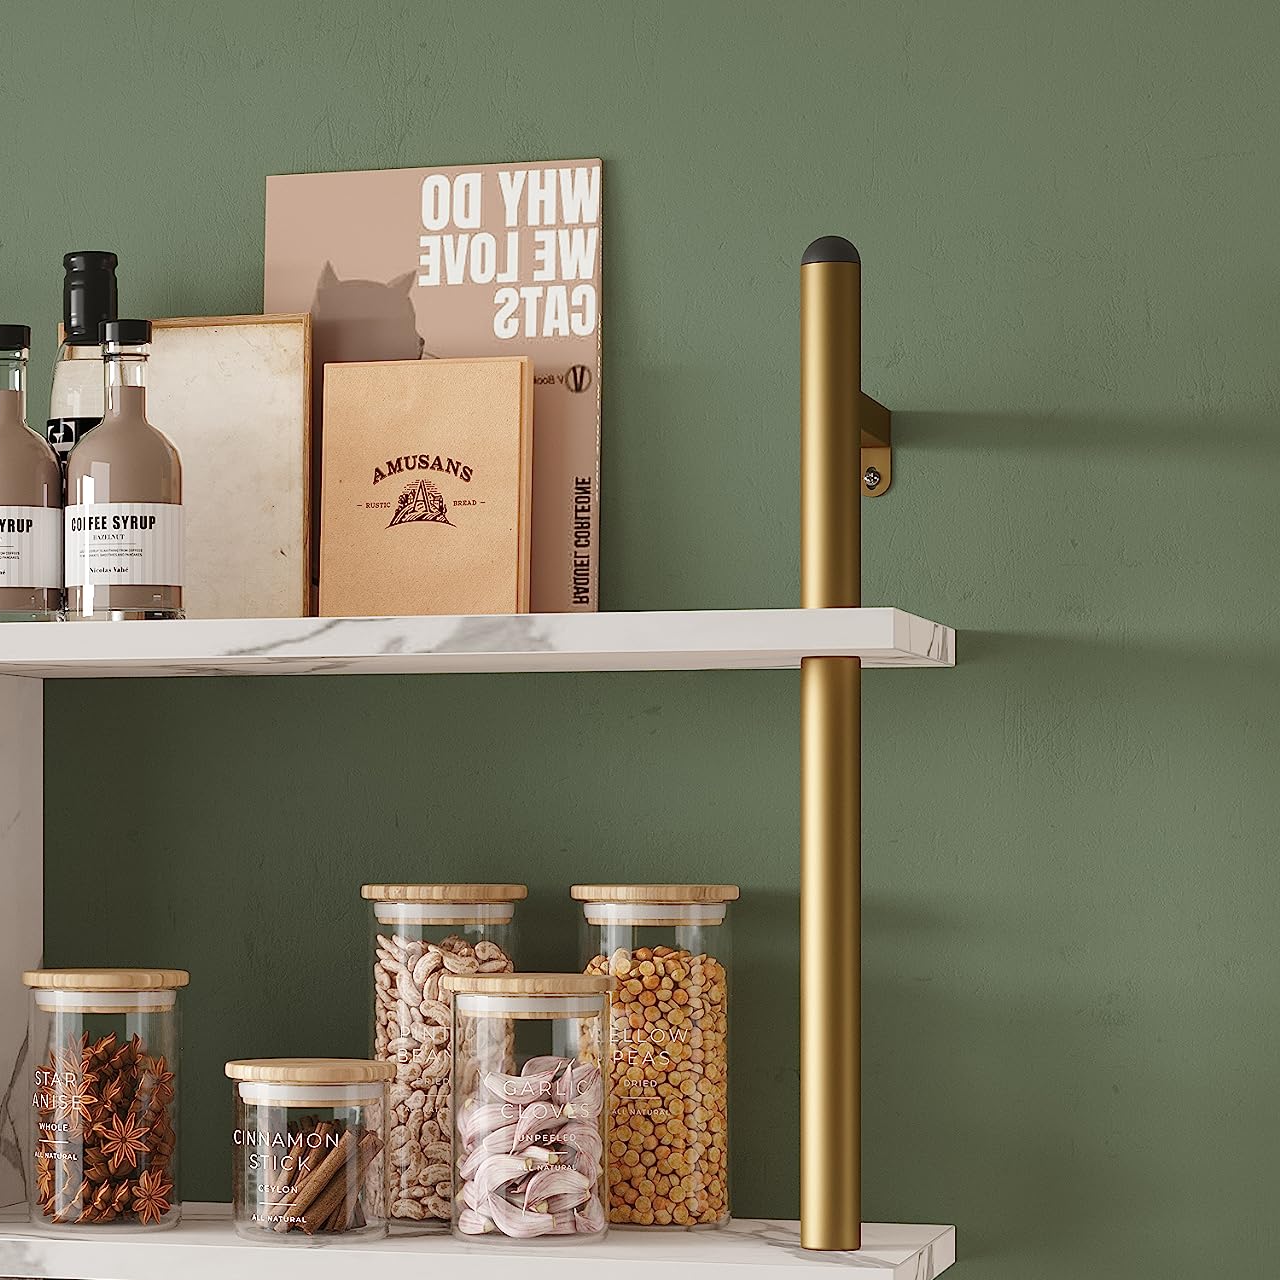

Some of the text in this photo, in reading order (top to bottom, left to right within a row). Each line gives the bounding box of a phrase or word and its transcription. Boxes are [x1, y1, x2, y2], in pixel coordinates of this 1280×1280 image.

[372, 454, 474, 486] AMUSANS
[113, 515, 156, 530] SYRUP
[610, 1028, 688, 1043] ELLOW
[614, 1050, 670, 1065] PEAS
[35, 1071, 76, 1087] STAR
[624, 1080, 658, 1088] DRIED
[503, 1080, 589, 1096] GARLIC
[32, 1093, 81, 1110] ANISE
[501, 1104, 590, 1119] CLOVES
[39, 1122, 68, 1132] WHOLE
[233, 1129, 339, 1148] CINNAMON
[518, 1133, 577, 1142] UNPEELED
[44, 1152, 78, 1161] NATURAL
[249, 1153, 311, 1171] STICK
[536, 1163, 577, 1171] NATURAL
[258, 1184, 298, 1194] CEYLON
[267, 1215, 307, 1223] NATURAL
